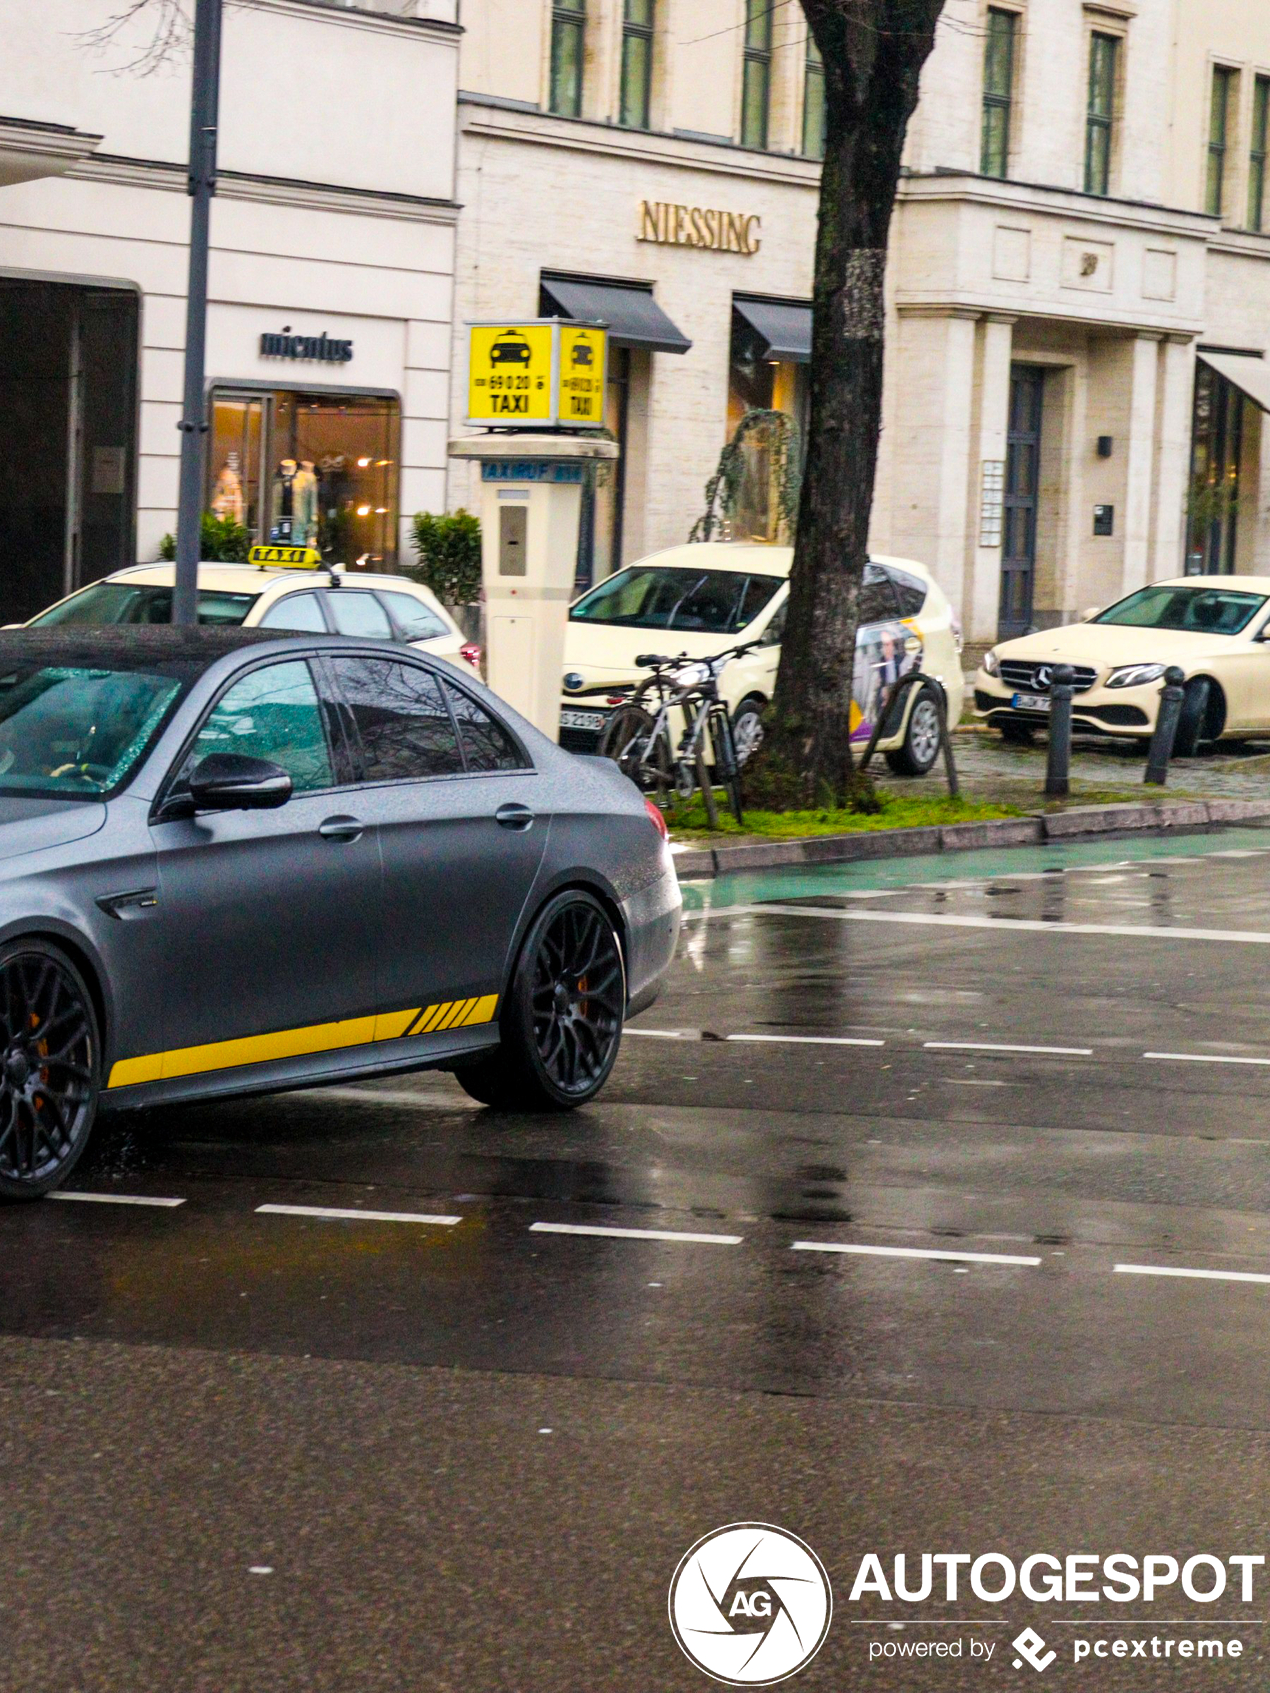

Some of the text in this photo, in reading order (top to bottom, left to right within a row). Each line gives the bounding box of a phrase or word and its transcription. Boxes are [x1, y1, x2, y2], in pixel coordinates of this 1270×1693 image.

[635, 200, 763, 256] NIESSING
[260, 325, 353, 362] mientus
[490, 394, 529, 413] TAXI
[570, 396, 593, 416] TAXI
[253, 547, 307, 563] TAXI
